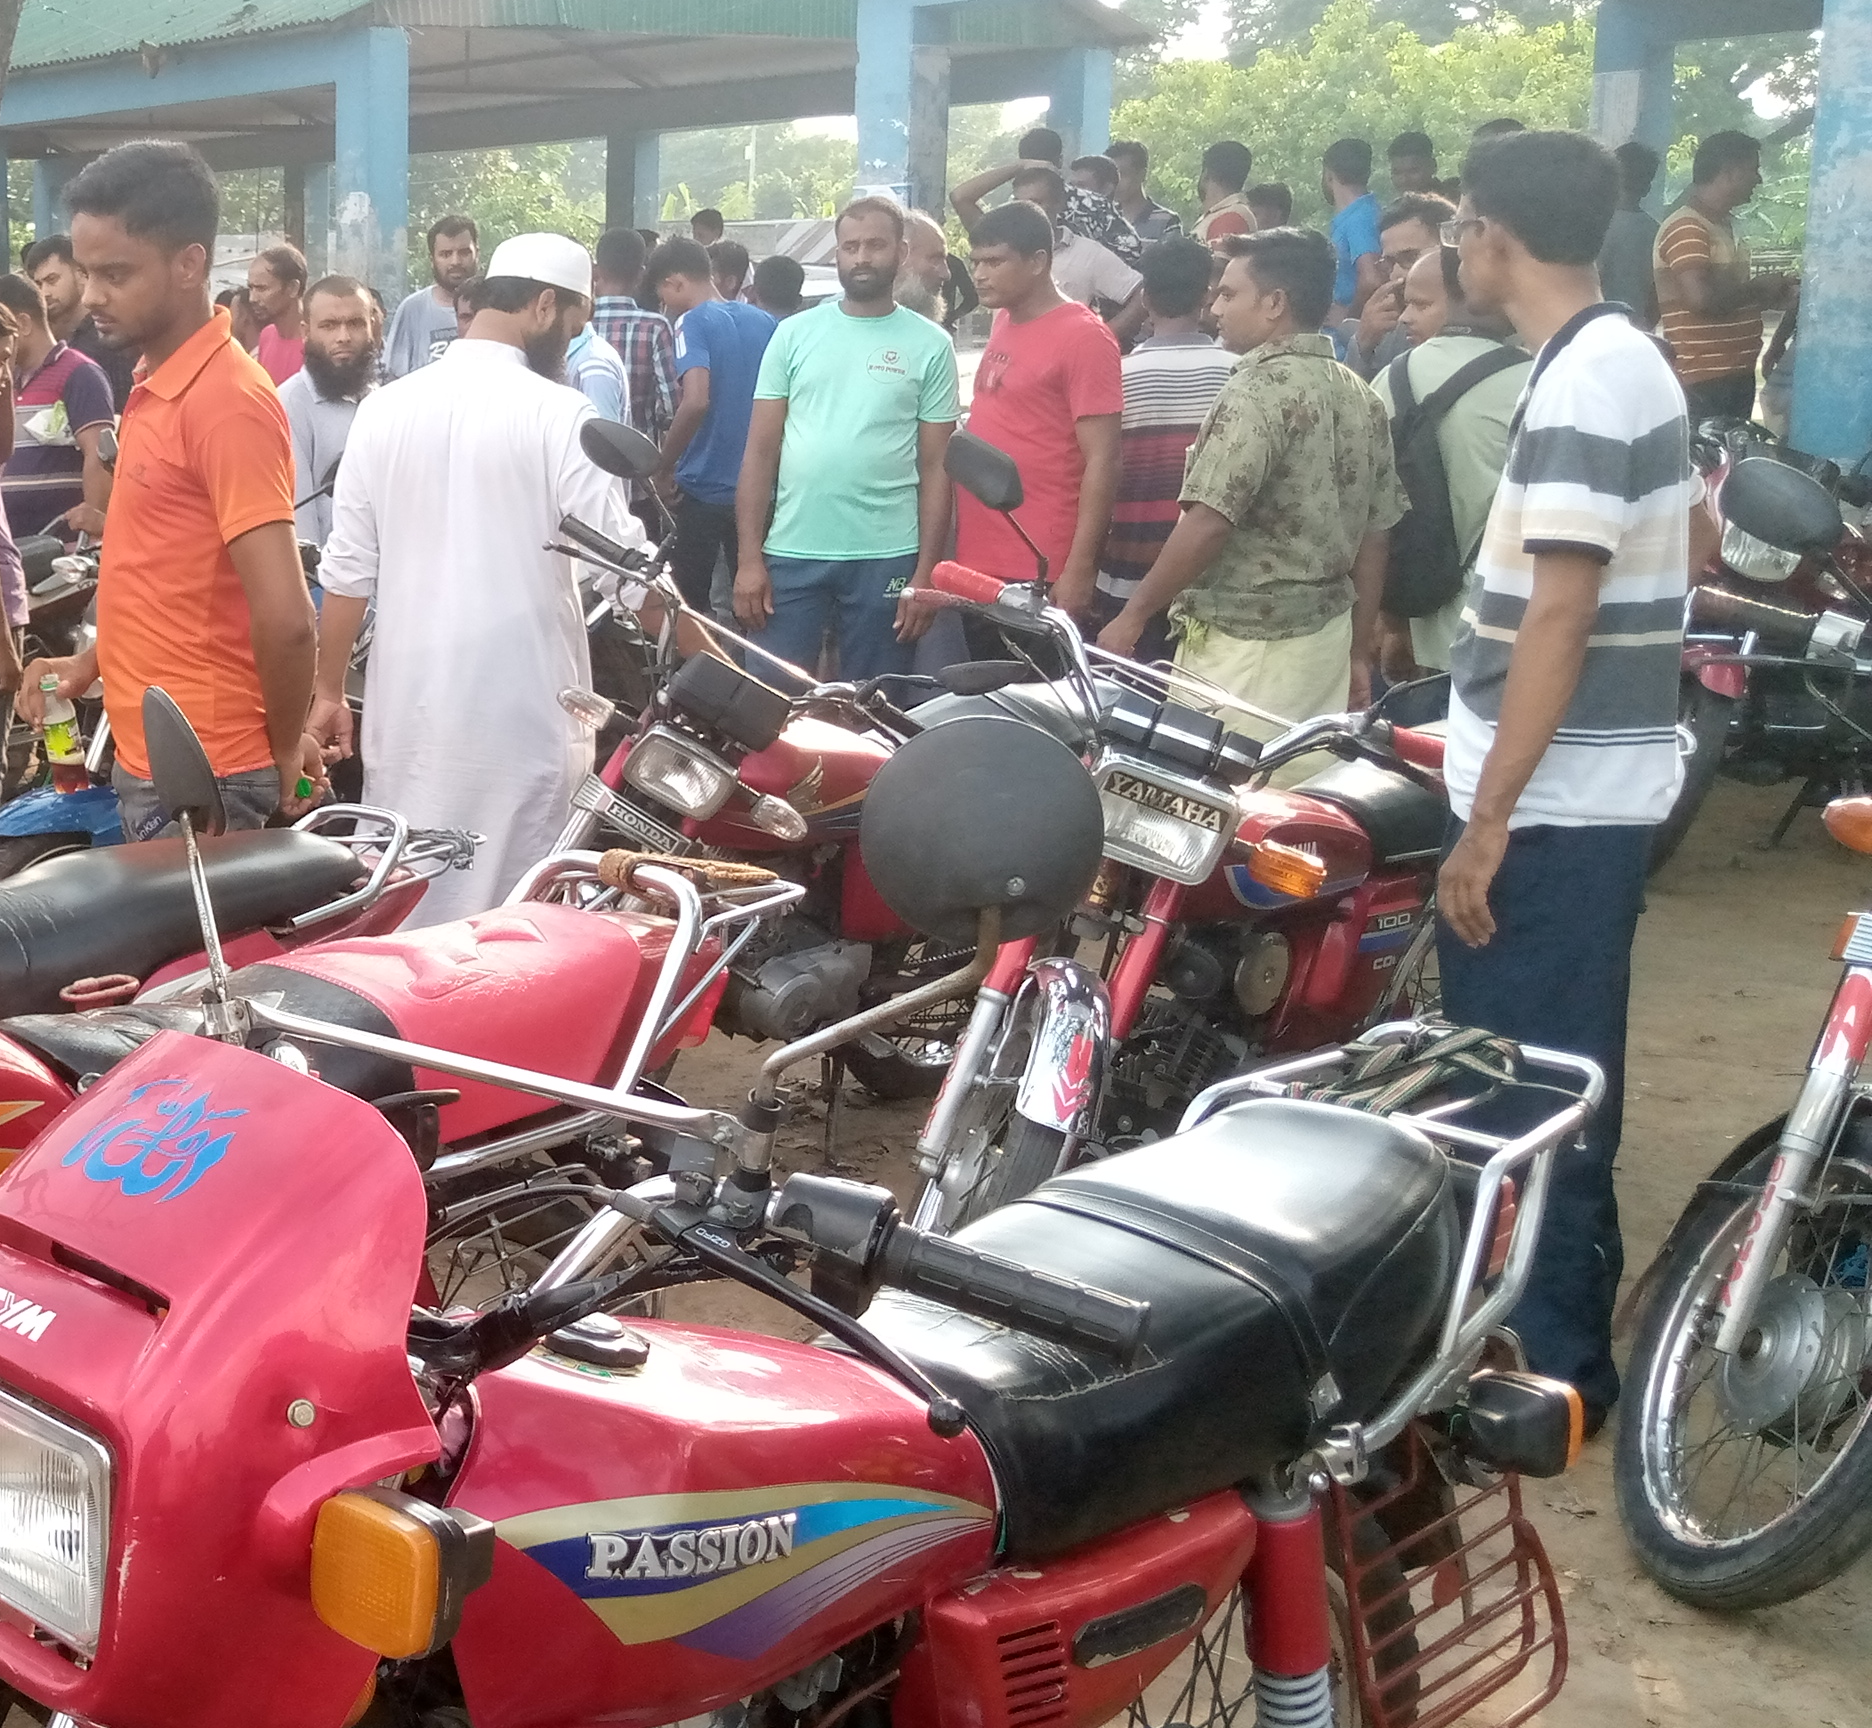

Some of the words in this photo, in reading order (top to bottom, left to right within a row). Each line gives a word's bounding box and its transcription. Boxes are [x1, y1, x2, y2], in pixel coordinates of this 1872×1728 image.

[610, 802, 673, 850] HONDA
[1110, 772, 1223, 832] YAMAHA
[1378, 912, 1412, 930] 100
[585, 1511, 798, 1580] PASSION
